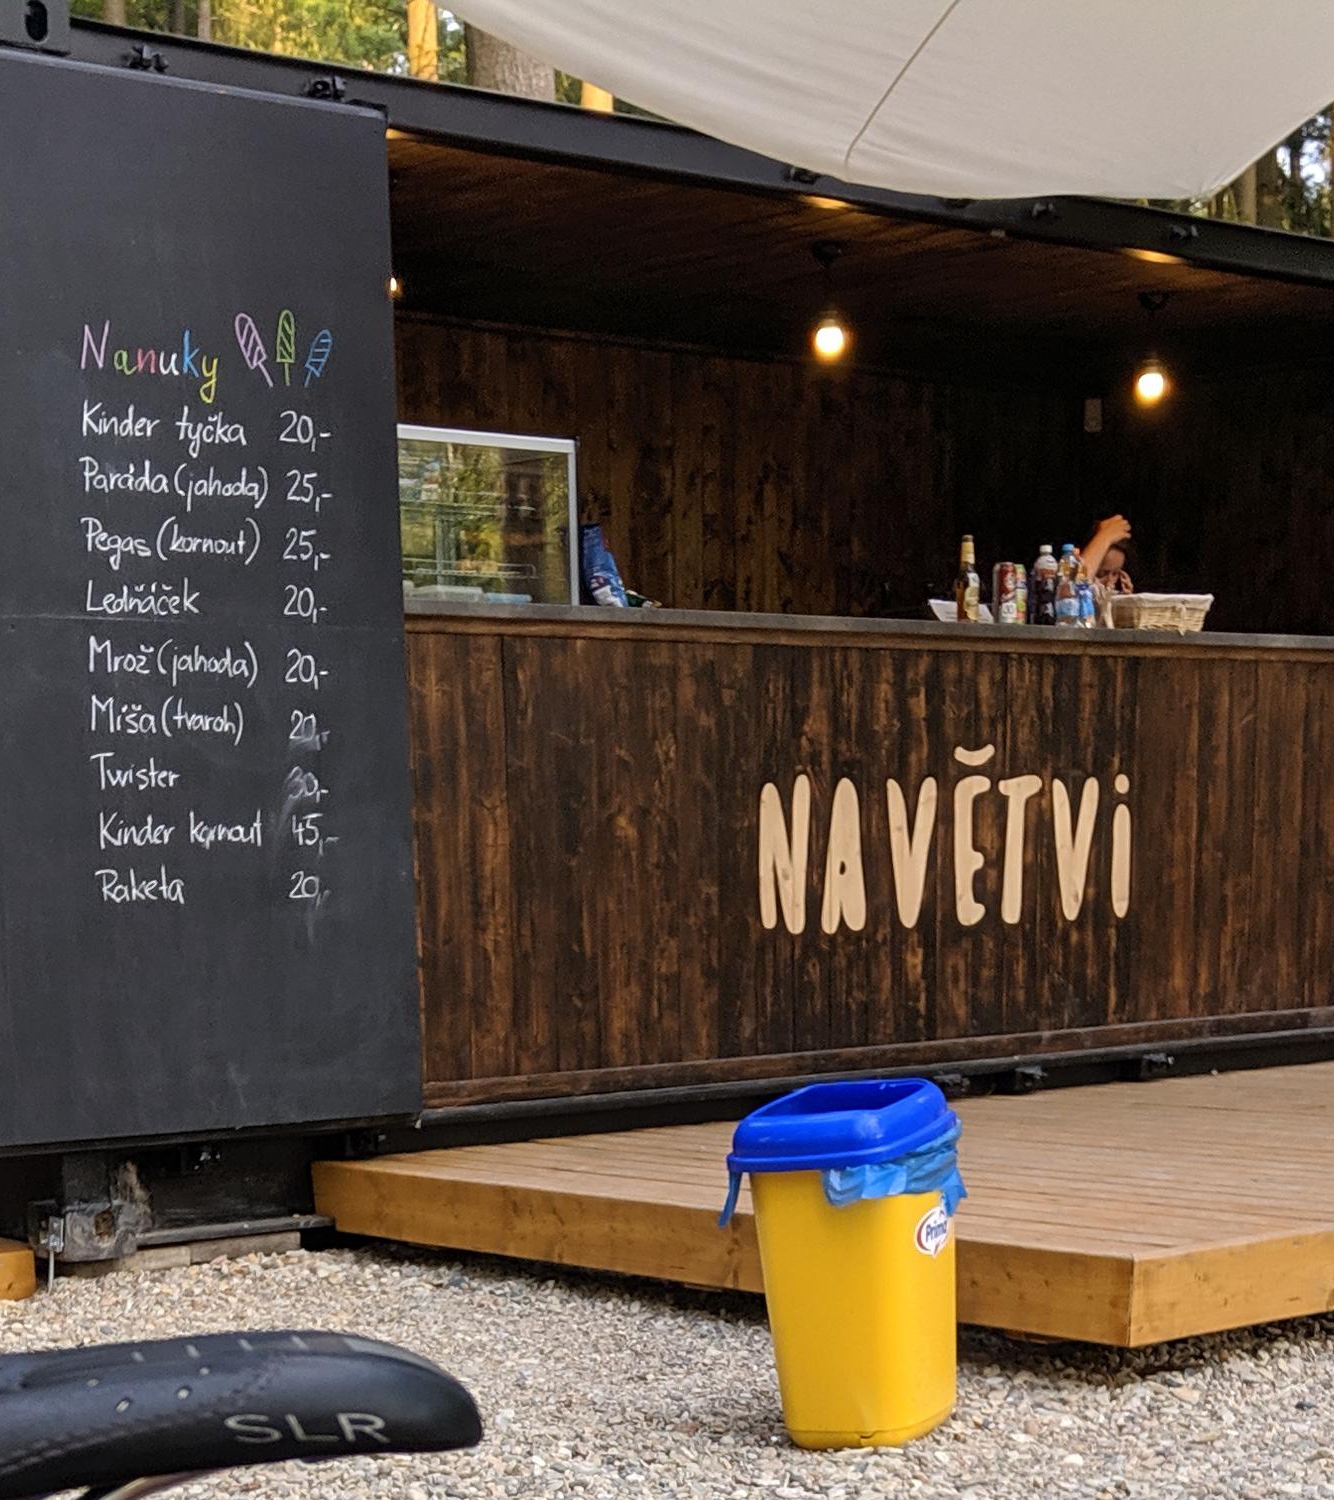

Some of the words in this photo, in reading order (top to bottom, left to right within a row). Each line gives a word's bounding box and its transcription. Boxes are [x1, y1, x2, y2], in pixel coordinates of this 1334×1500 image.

[79, 319, 219, 404] Nanuky
[82, 399, 160, 438] Kinder
[176, 405, 247, 458] tyčka
[278, 410, 332, 452] 20,-
[79, 456, 169, 493] Paráda
[174, 463, 269, 512] (jahoda)
[285, 469, 333, 512] 25,-
[80, 516, 152, 571] Pegas
[157, 516, 261, 566] (kornout)
[282, 528, 331, 571] 25,-
[86, 577, 200, 615] Ledňáček
[283, 584, 328, 624] 20,-
[88, 635, 155, 674] Mrož
[157, 638, 258, 689] (jahoda)
[284, 648, 329, 690] 20,-
[91, 695, 158, 735] Míša
[161, 696, 244, 746] (tvaroh)
[89, 752, 181, 791] Twister
[100, 811, 175, 850] Kinder
[291, 813, 340, 857] 45,-
[94, 865, 185, 904] Raketa
[223, 1412, 388, 1444] SLR
